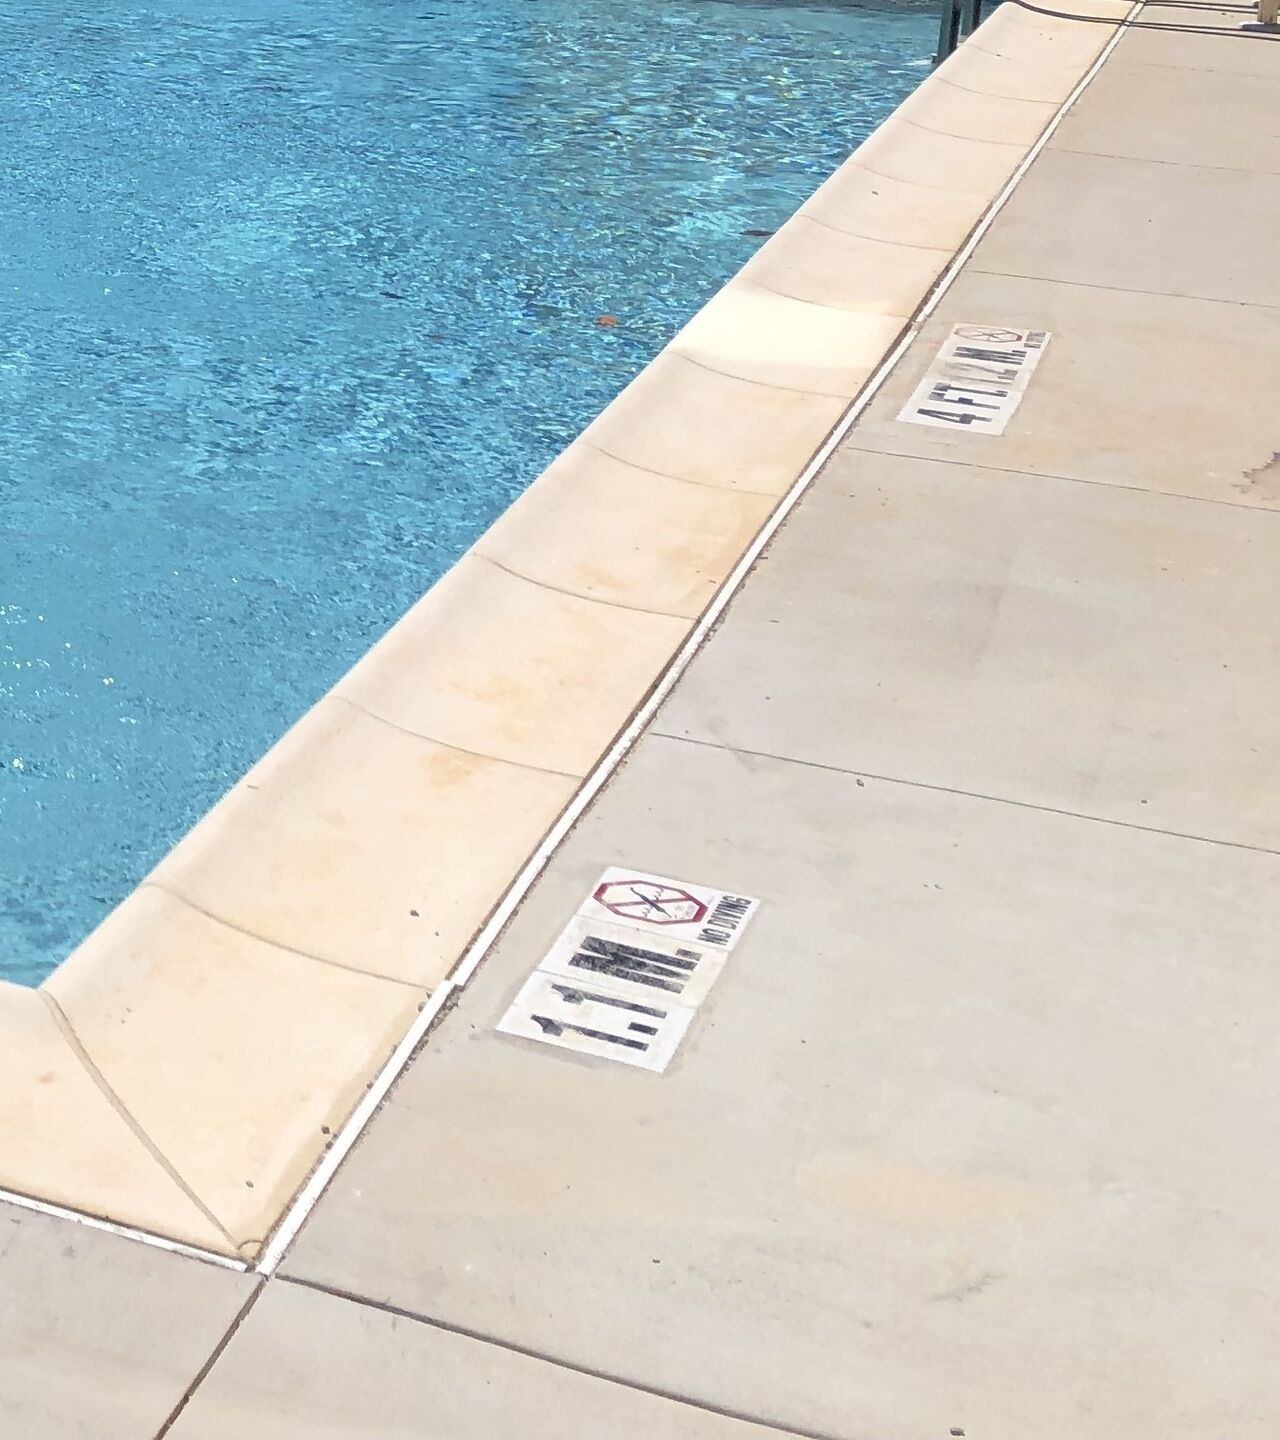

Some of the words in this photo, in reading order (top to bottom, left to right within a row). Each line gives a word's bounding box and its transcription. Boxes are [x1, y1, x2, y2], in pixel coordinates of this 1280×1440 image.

[951, 346, 1028, 366] M.
[927, 382, 1009, 410] FT.
[917, 408, 993, 425] 4
[706, 895, 753, 930] DIVING
[696, 926, 732, 947] NO
[567, 935, 704, 995] M.
